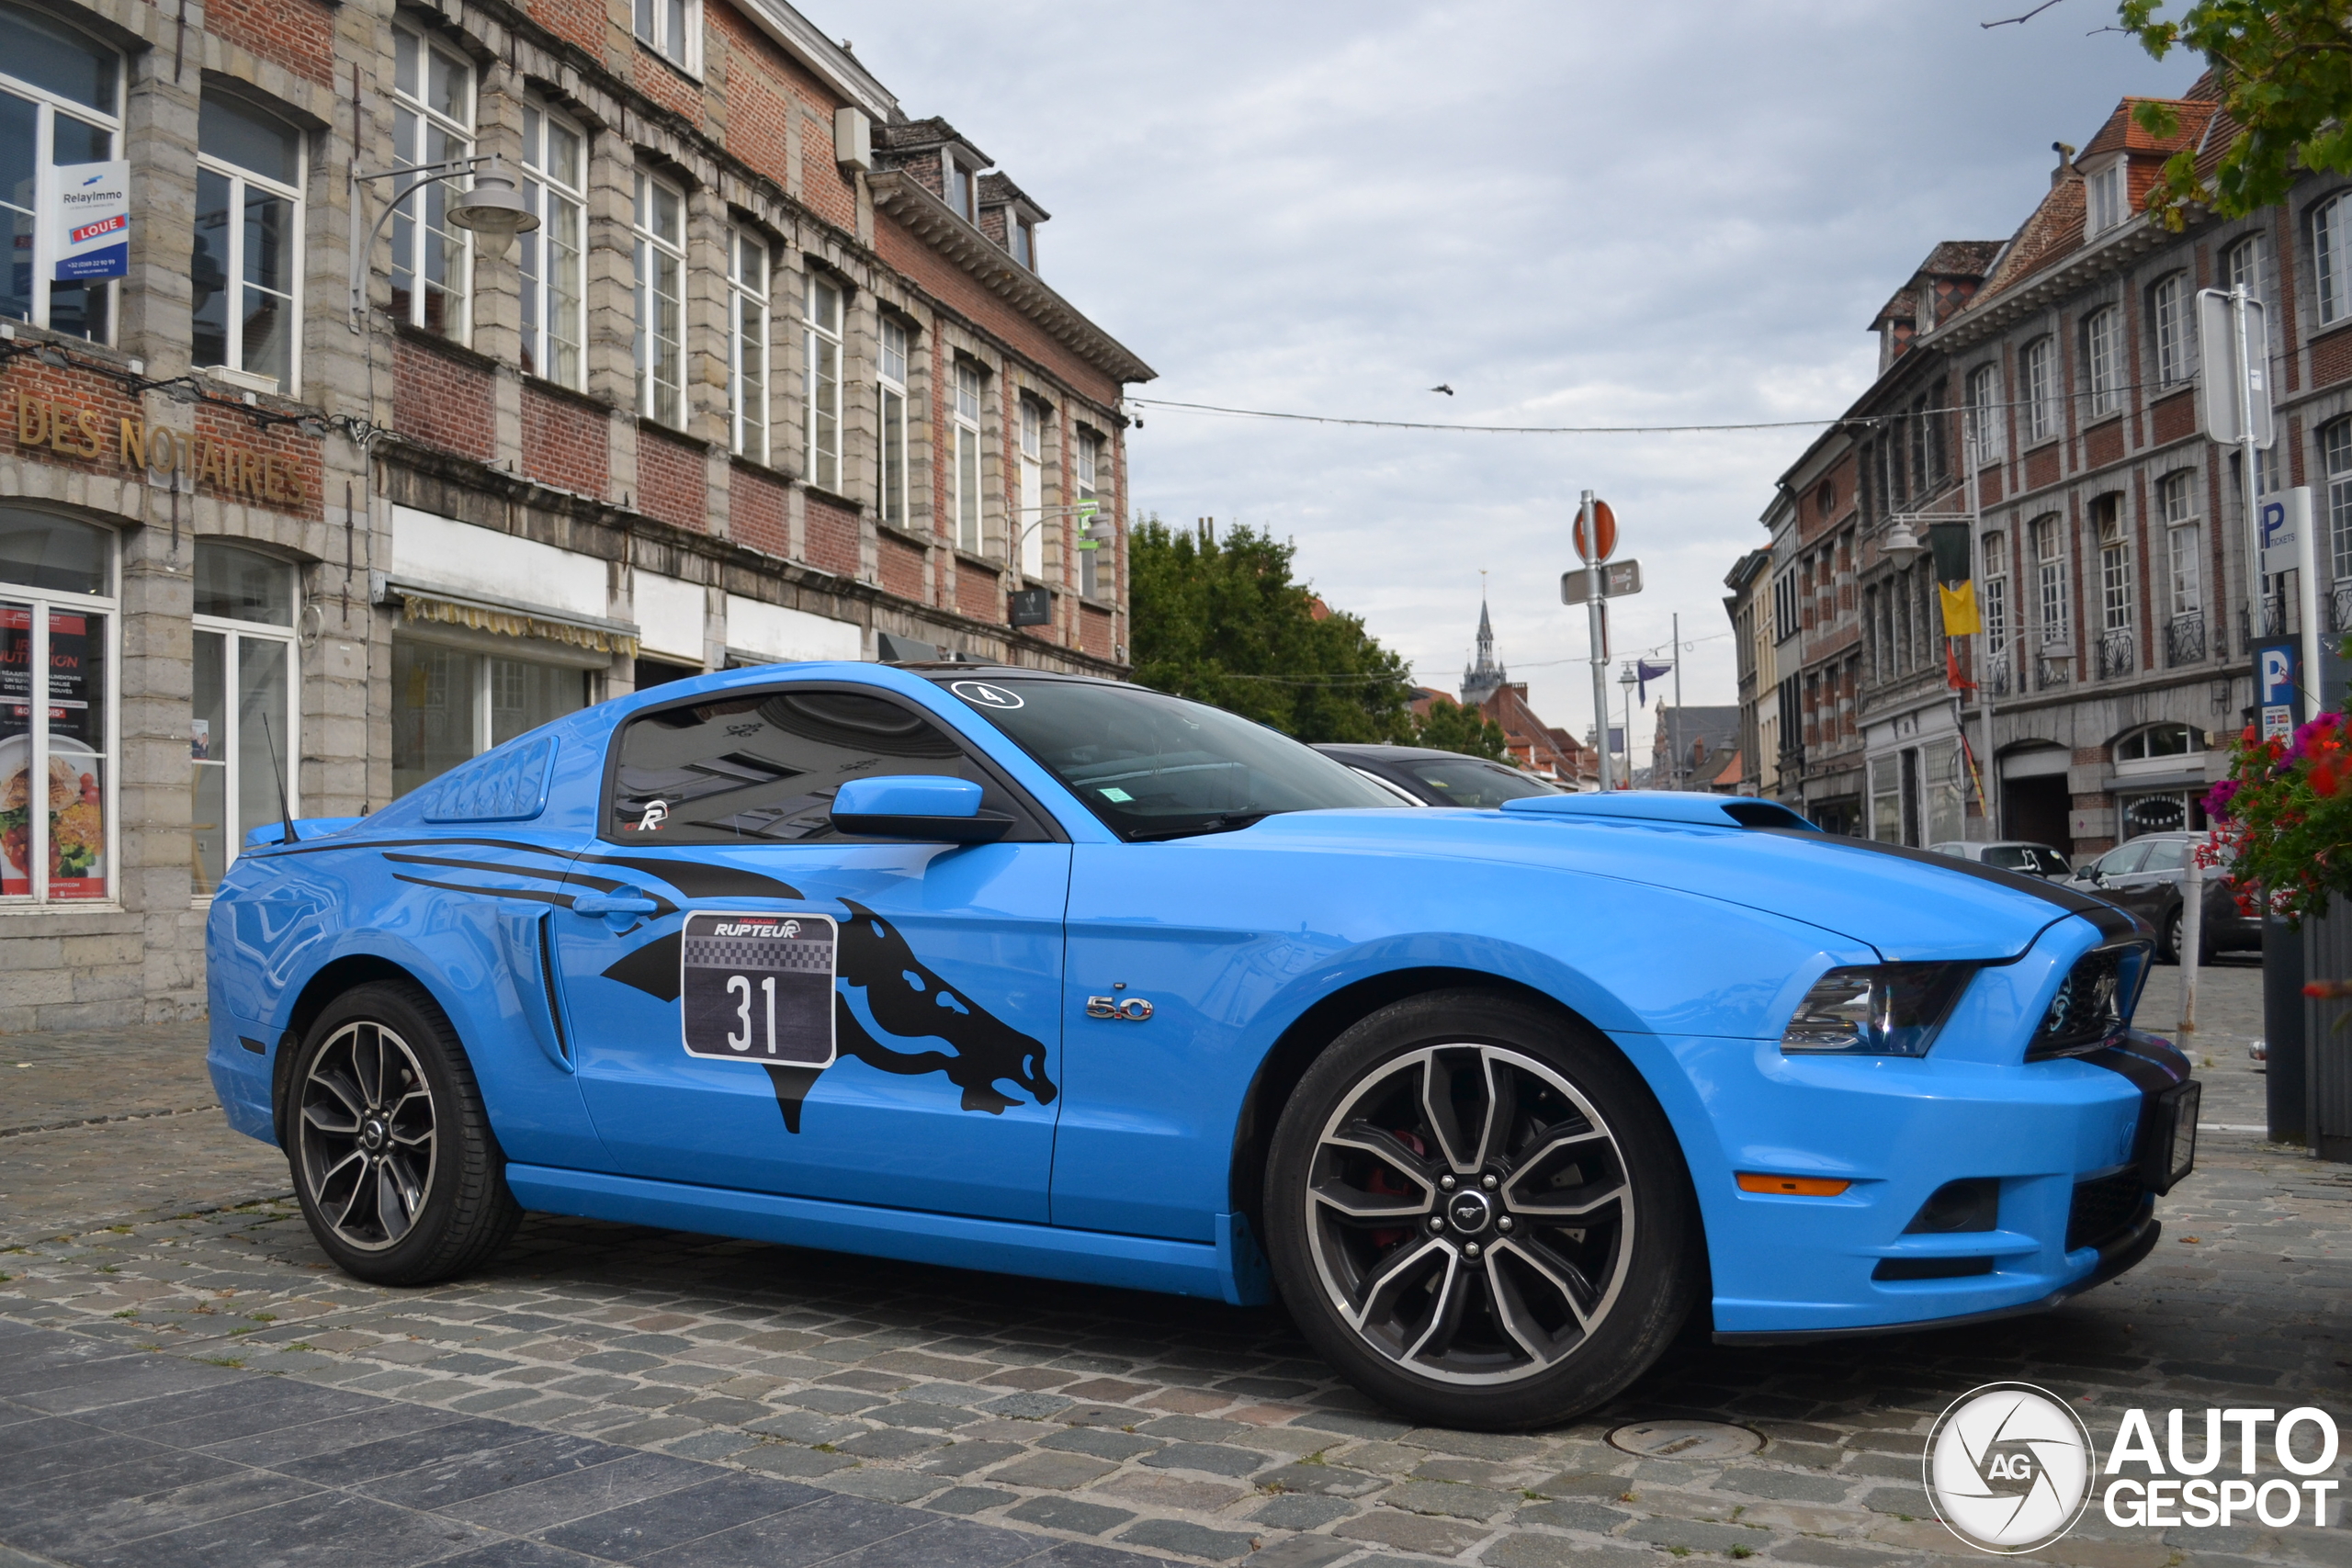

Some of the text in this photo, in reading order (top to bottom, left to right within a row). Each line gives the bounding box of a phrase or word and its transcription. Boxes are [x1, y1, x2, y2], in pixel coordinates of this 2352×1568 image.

[63, 191, 122, 203] RelayImmo
[81, 219, 119, 239] LOUE
[18, 392, 307, 505] DES NOTAIRES
[2263, 502, 2285, 549] P
[2270, 532, 2296, 548] TICKETS
[2262, 650, 2288, 703] P
[977, 685, 1007, 704] 4
[714, 922, 800, 939] RUPTEUR
[727, 975, 776, 1055] 31
[1086, 996, 1153, 1021] 5.0
